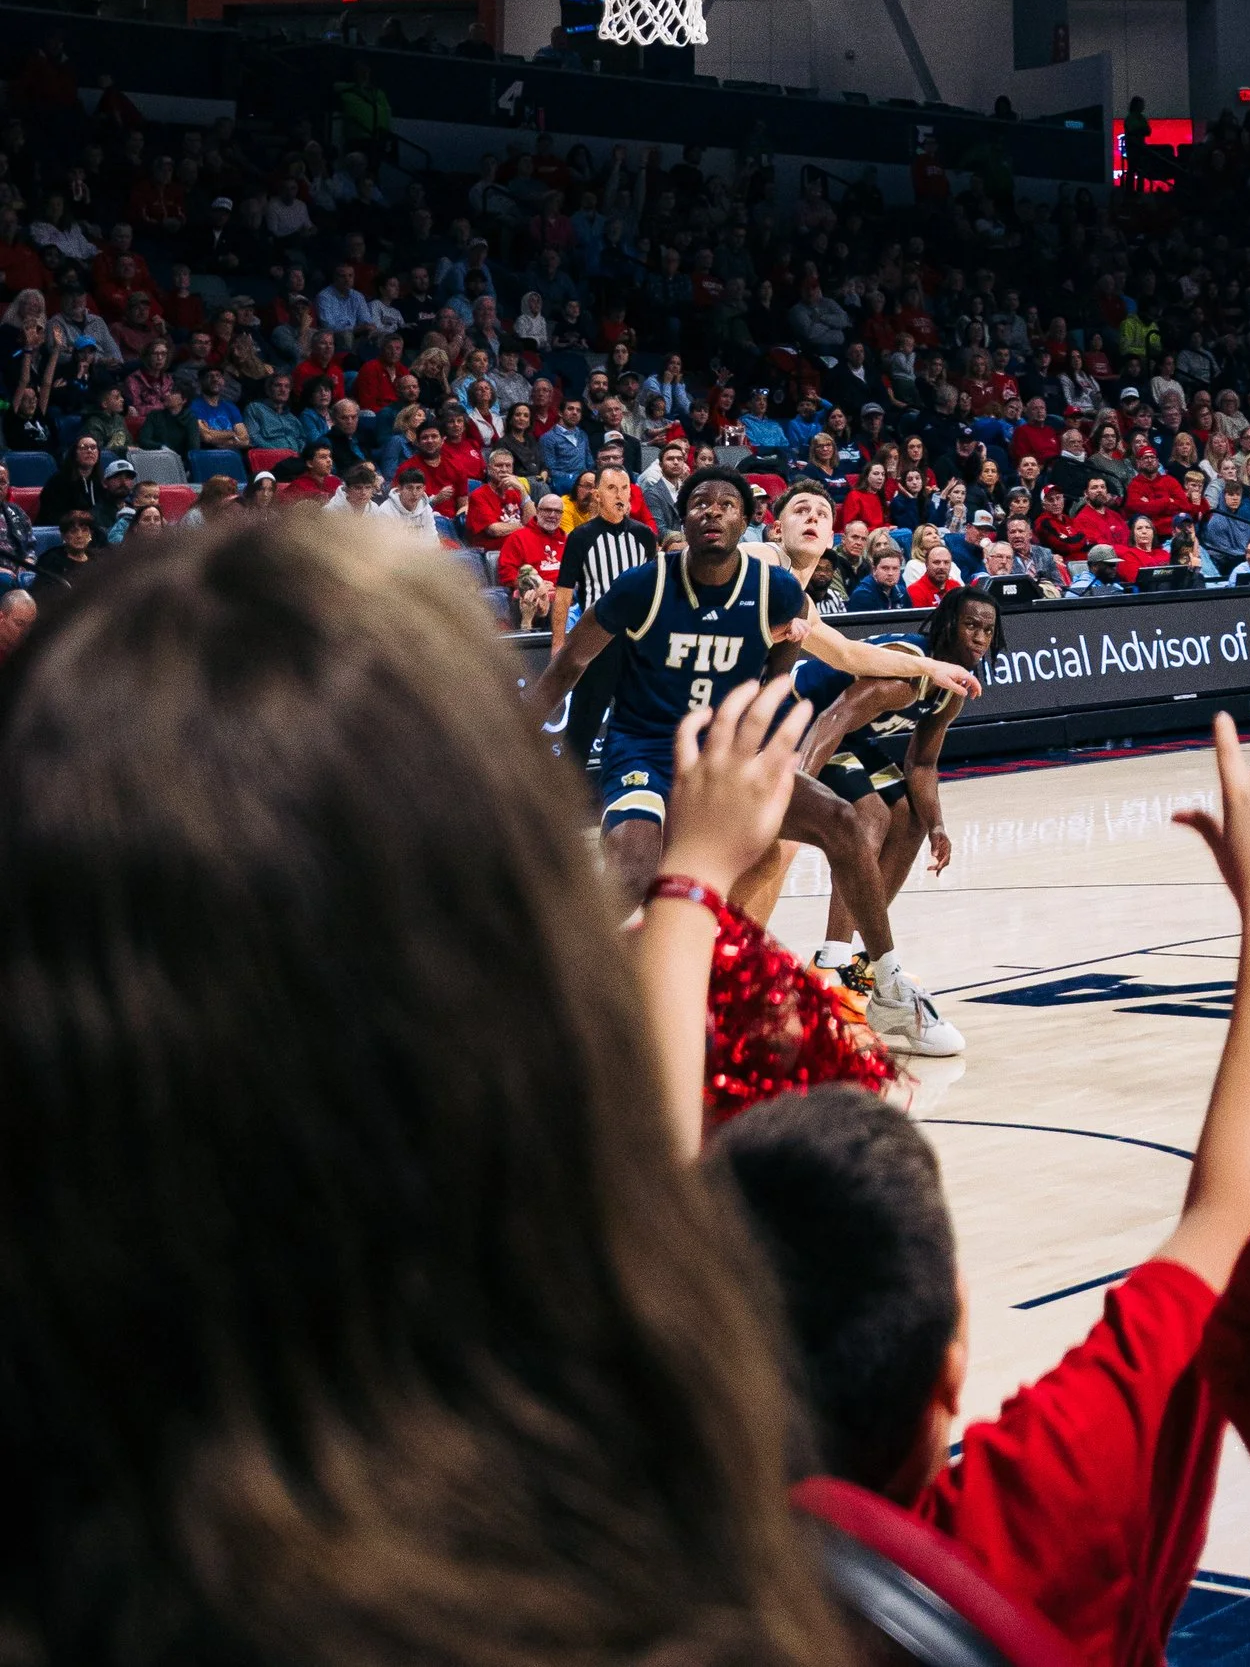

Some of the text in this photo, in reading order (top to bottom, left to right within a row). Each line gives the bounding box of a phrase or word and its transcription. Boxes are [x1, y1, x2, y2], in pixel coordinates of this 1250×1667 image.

[498, 80, 524, 116] 4
[665, 632, 745, 673] FIU
[984, 621, 1248, 685] ancial Advisor of
[687, 678, 714, 711] 9
